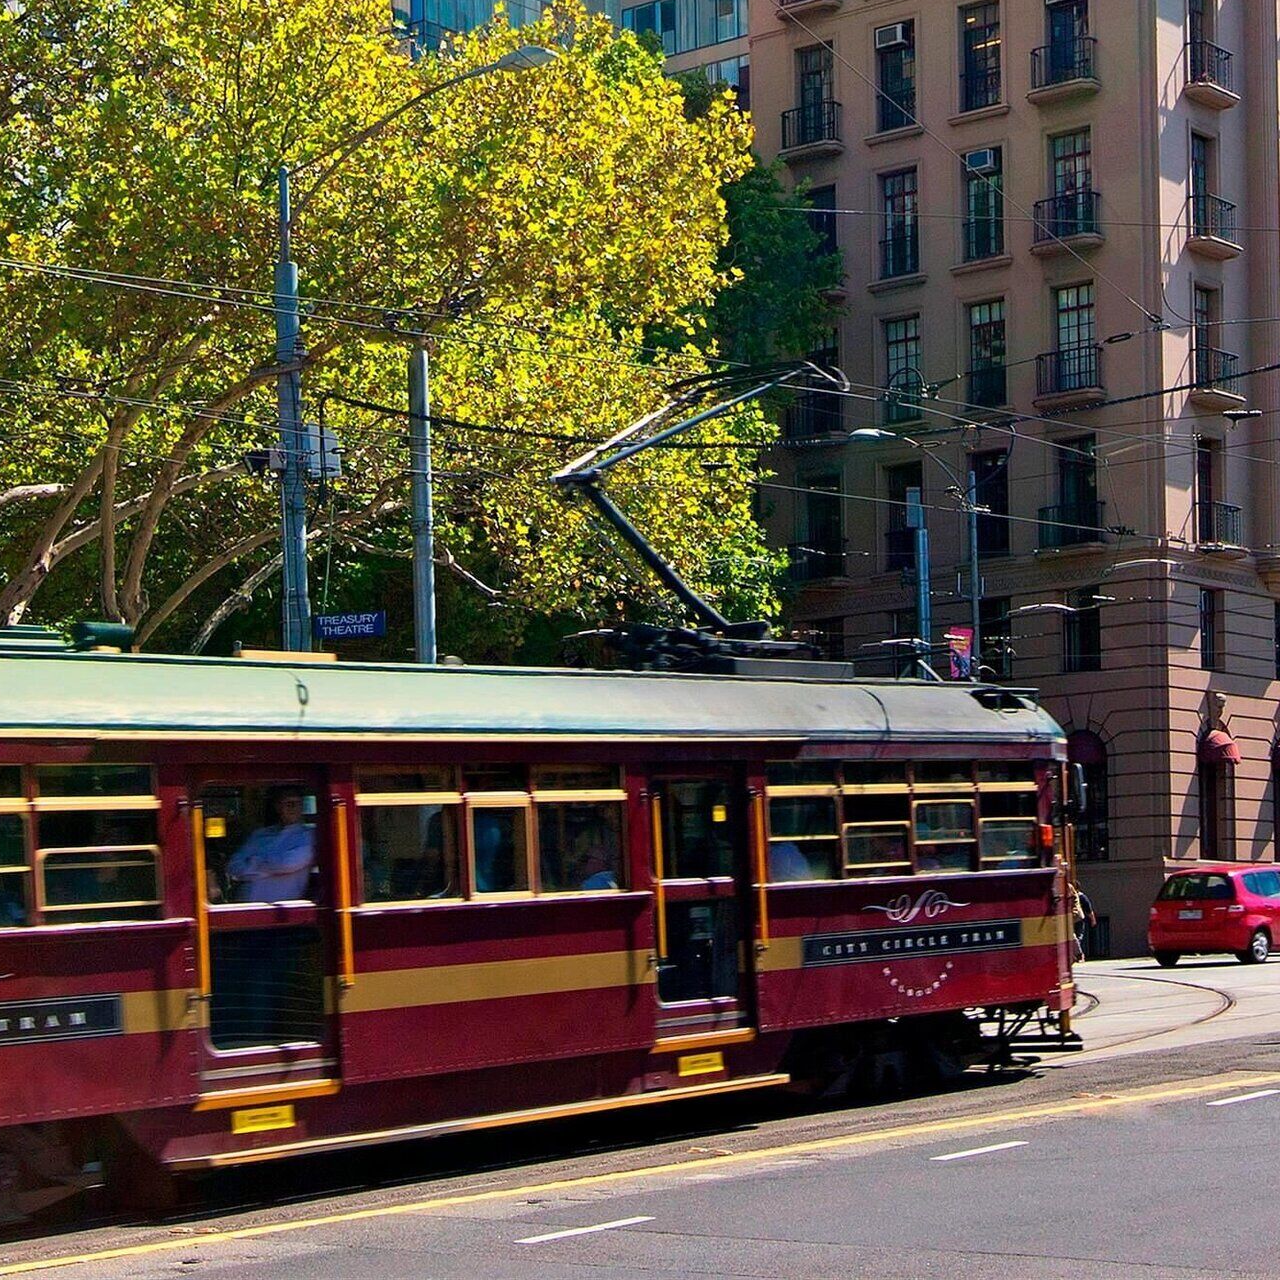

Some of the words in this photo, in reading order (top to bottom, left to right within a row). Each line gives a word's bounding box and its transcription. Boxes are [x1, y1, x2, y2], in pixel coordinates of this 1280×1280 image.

[317, 612, 377, 626] TREASURY
[322, 623, 374, 636] THEATRE
[822, 941, 868, 956] CITY
[882, 934, 949, 950] CIRCLE
[960, 930, 1005, 944] TRAM
